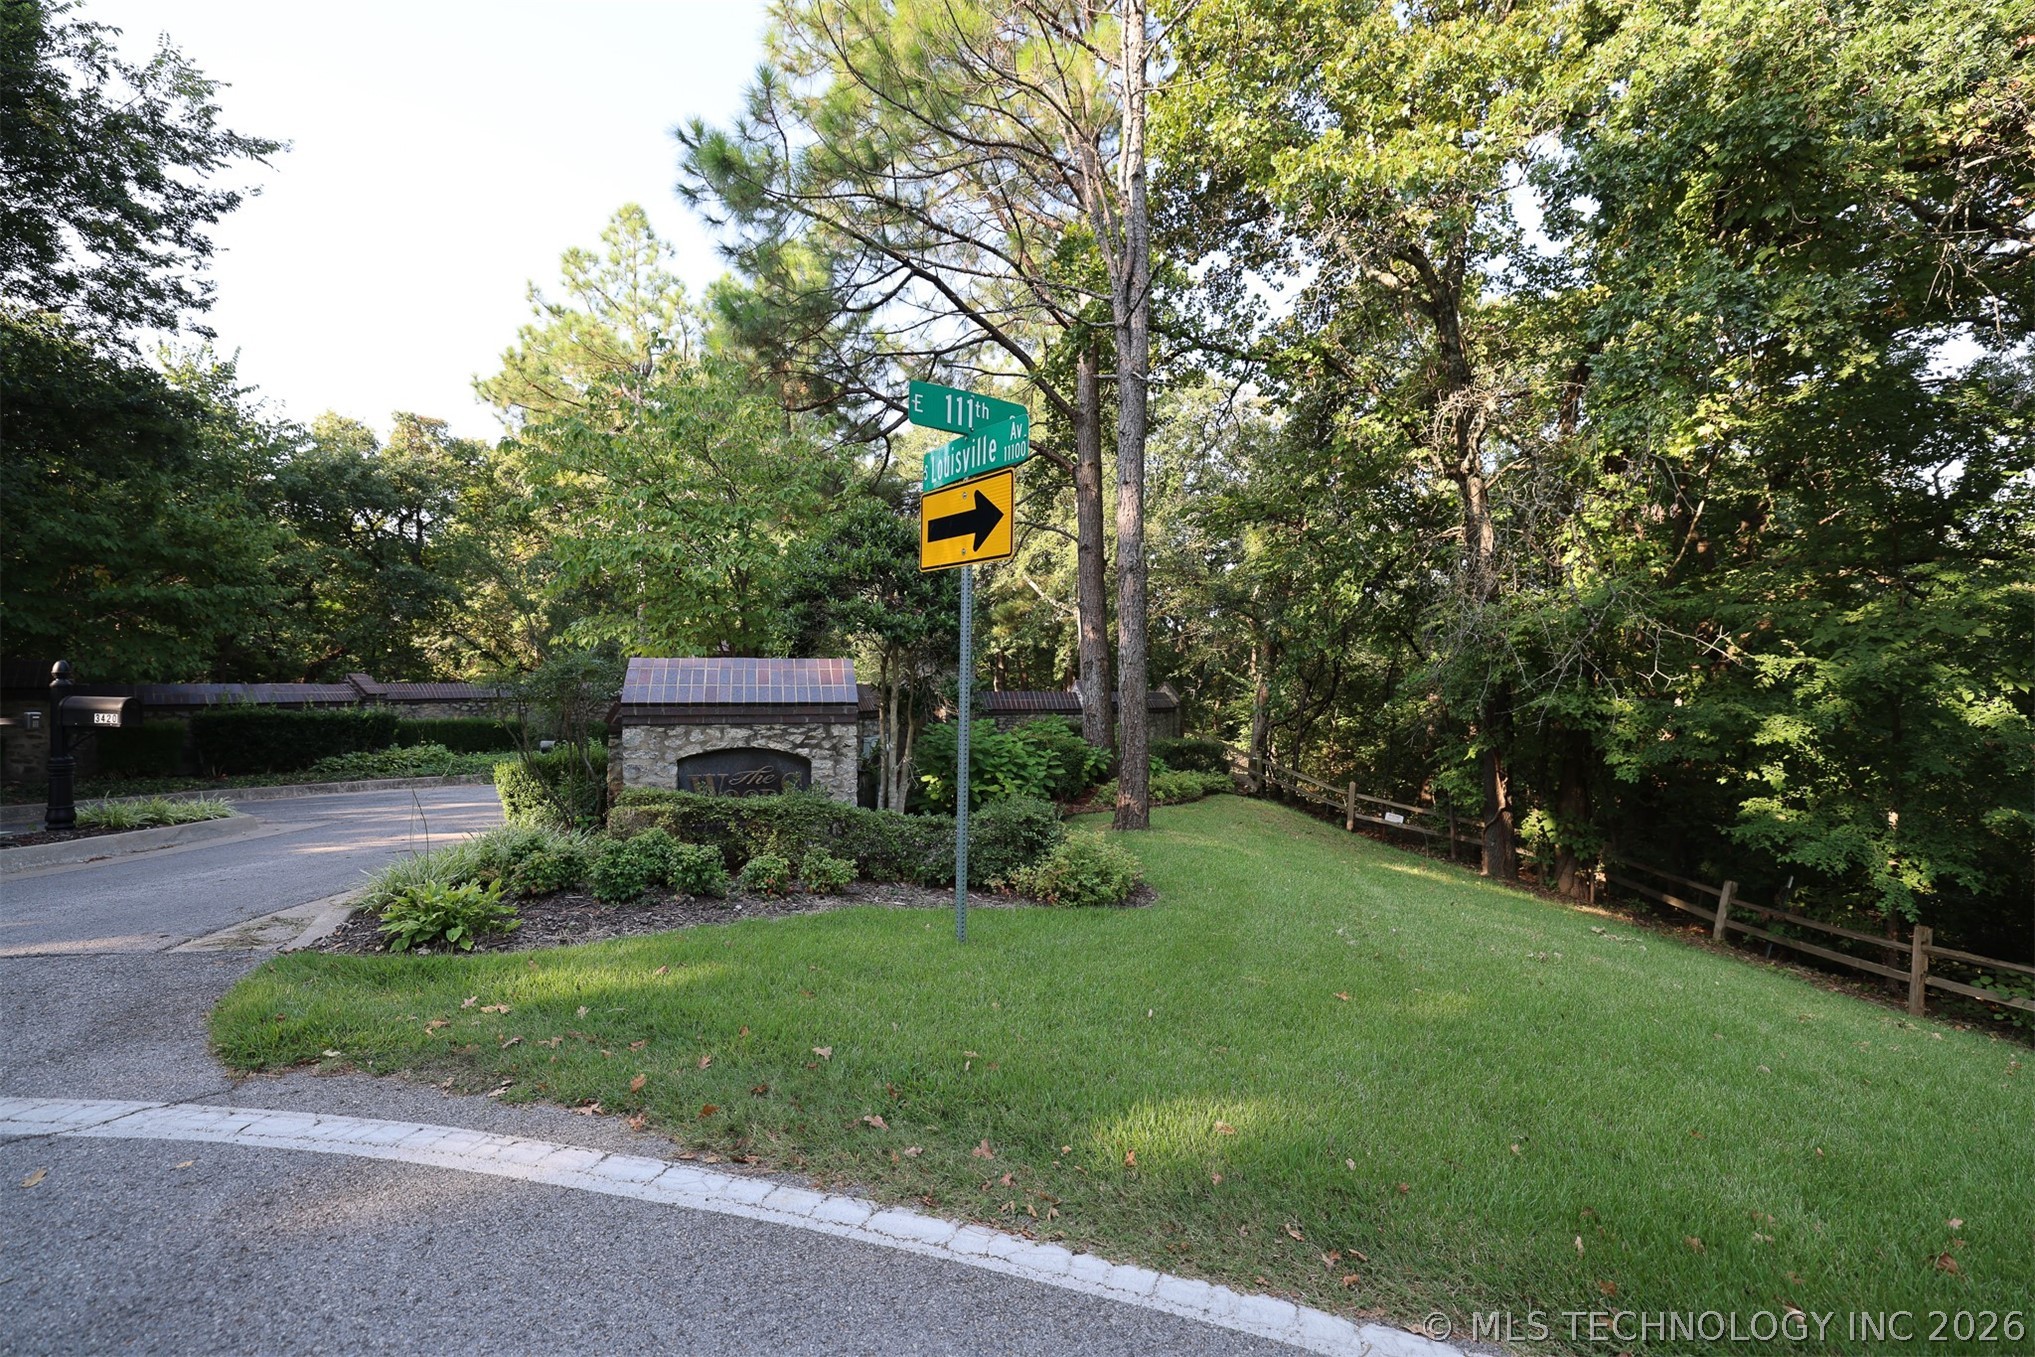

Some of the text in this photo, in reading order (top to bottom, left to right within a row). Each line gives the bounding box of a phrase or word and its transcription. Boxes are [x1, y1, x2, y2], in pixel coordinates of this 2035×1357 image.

[914, 393, 990, 429] E 111th
[931, 434, 997, 484] Louisville
[1010, 421, 1023, 441] Av
[1004, 440, 1026, 462] 11100
[95, 714, 118, 723] 3420
[728, 765, 776, 786] The
